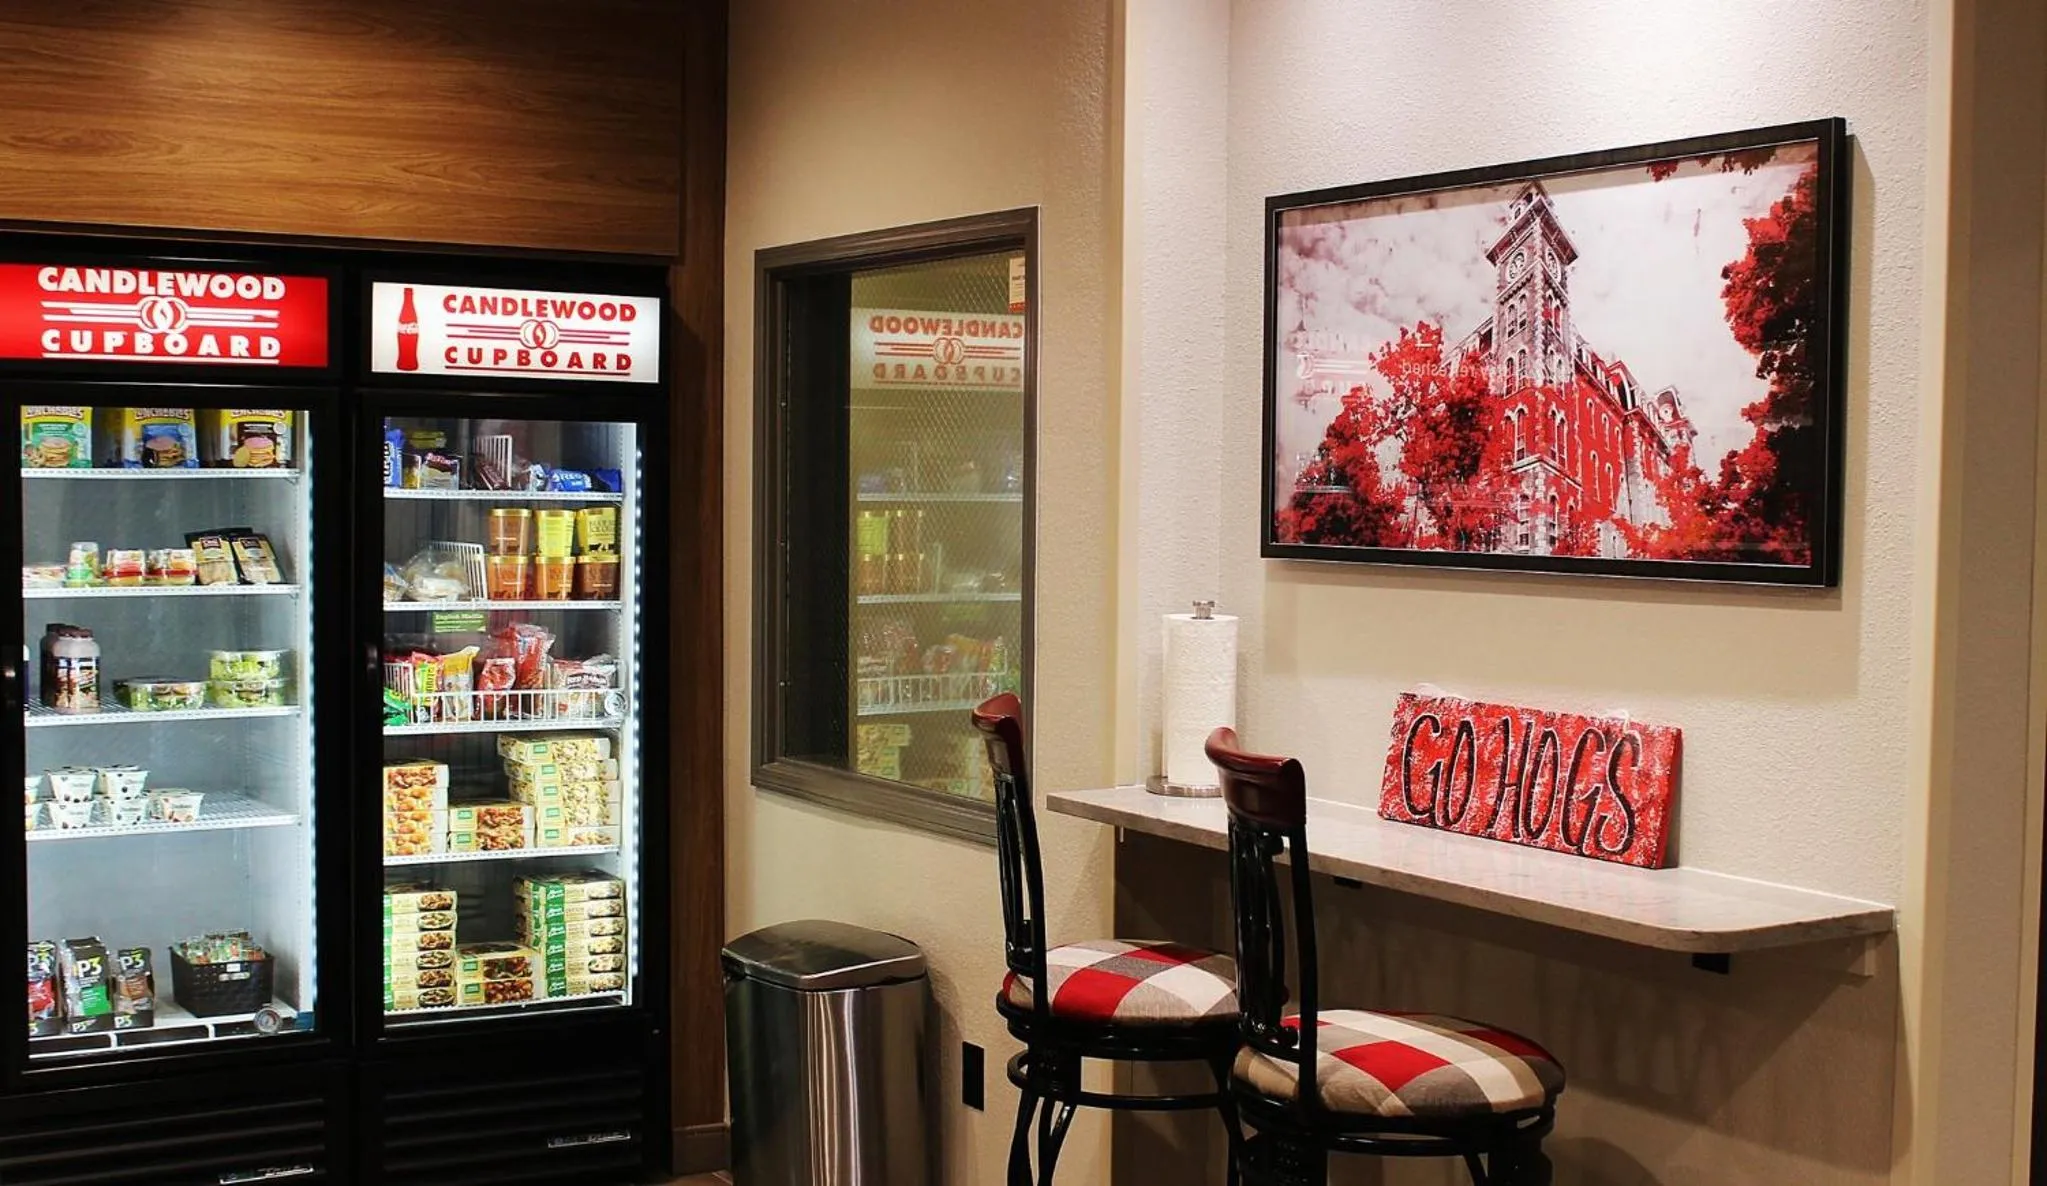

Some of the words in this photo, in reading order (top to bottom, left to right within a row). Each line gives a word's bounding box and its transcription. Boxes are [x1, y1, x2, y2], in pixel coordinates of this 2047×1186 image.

[38, 266, 286, 300] CANDLEWOOD
[443, 294, 637, 322] CANDLEWOOD
[41, 329, 281, 358] CUPBOARD
[445, 346, 632, 371] CUPBOARD
[1402, 714, 1477, 827] GO
[1487, 716, 1642, 856] HOGS
[77, 956, 102, 977] P3
[119, 953, 145, 970] P3
[72, 1021, 88, 1033] P3
[114, 1015, 133, 1029] P3
